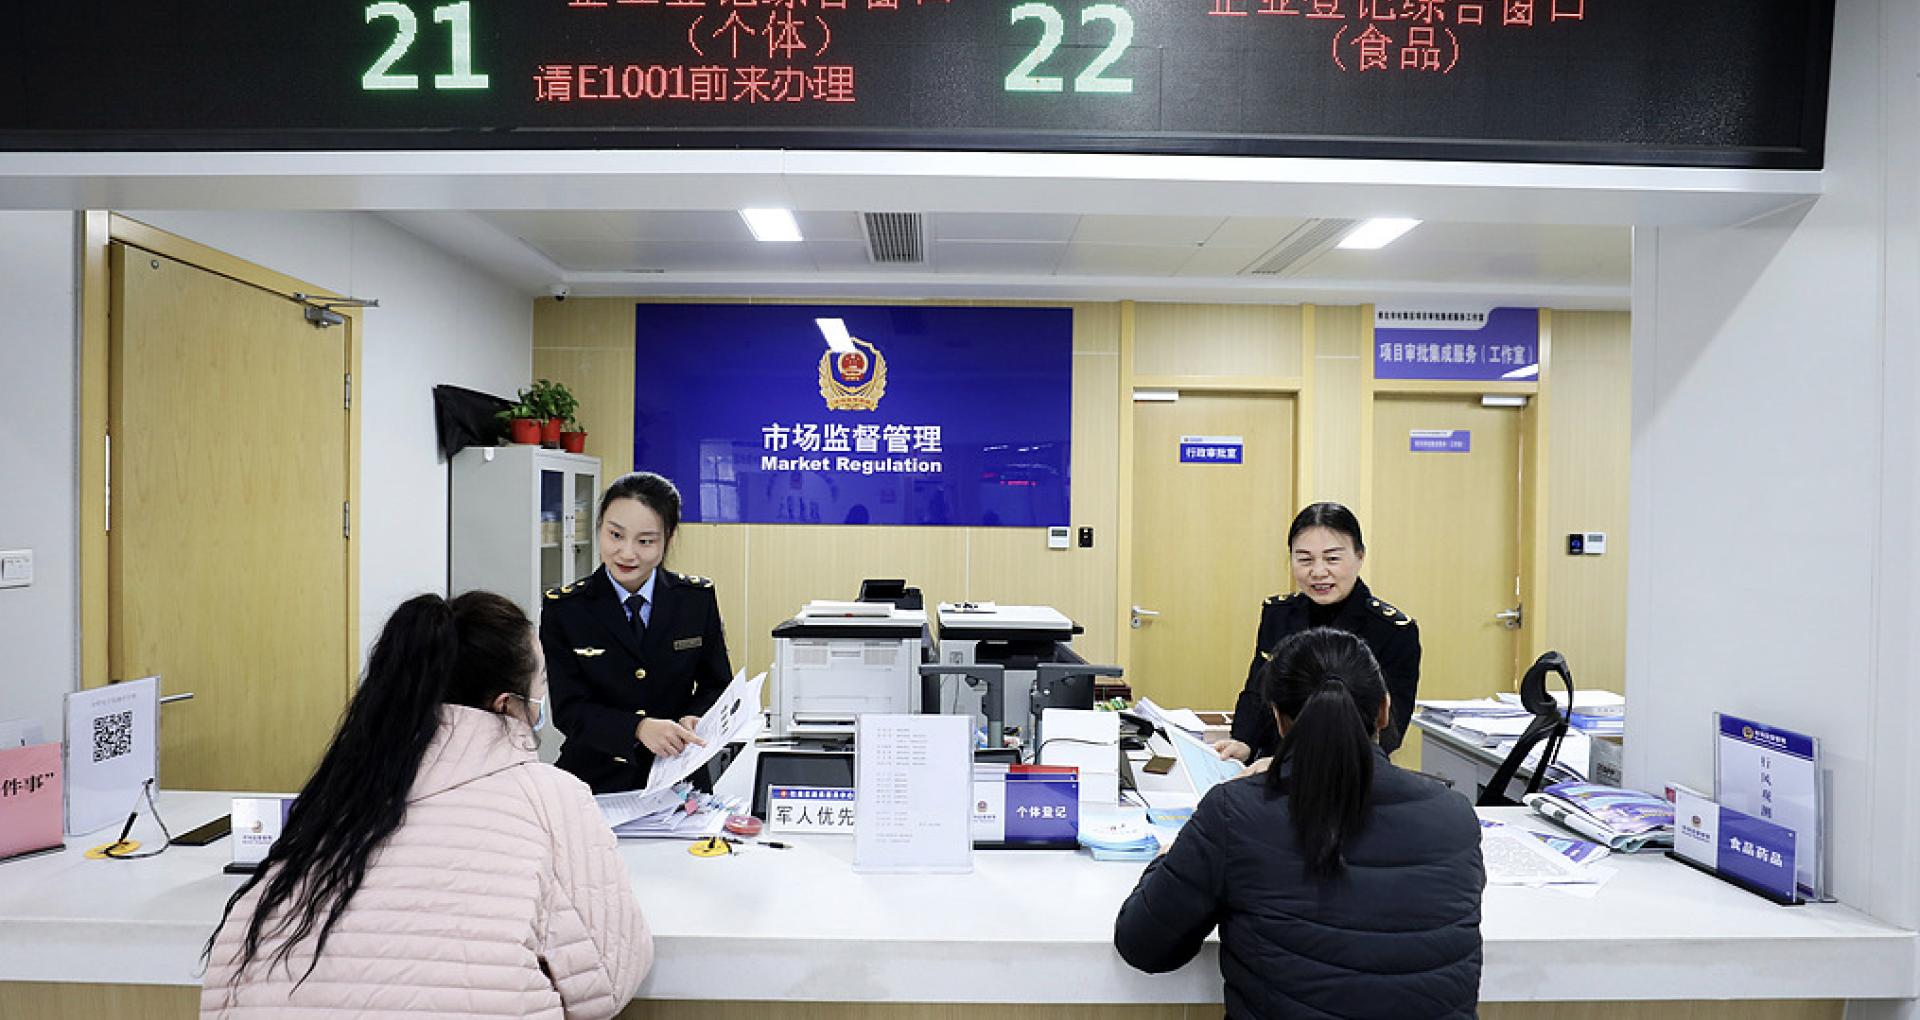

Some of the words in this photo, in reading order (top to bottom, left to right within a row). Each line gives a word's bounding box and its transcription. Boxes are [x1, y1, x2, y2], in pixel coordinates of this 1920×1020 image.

[362, 1, 489, 91] 21
[687, 9, 832, 59] （个体）
[1004, 2, 1134, 93] 22
[1332, 23, 1461, 74] （食品）
[533, 64, 855, 103] 请E1001前来办理
[761, 422, 943, 453] 市场监督管理
[761, 456, 830, 471] Market
[835, 457, 943, 475] Regulation
[776, 805, 855, 826] 军人优先
[1015, 805, 1068, 819] 个体登记
[1729, 836, 1783, 868] 食品药品
